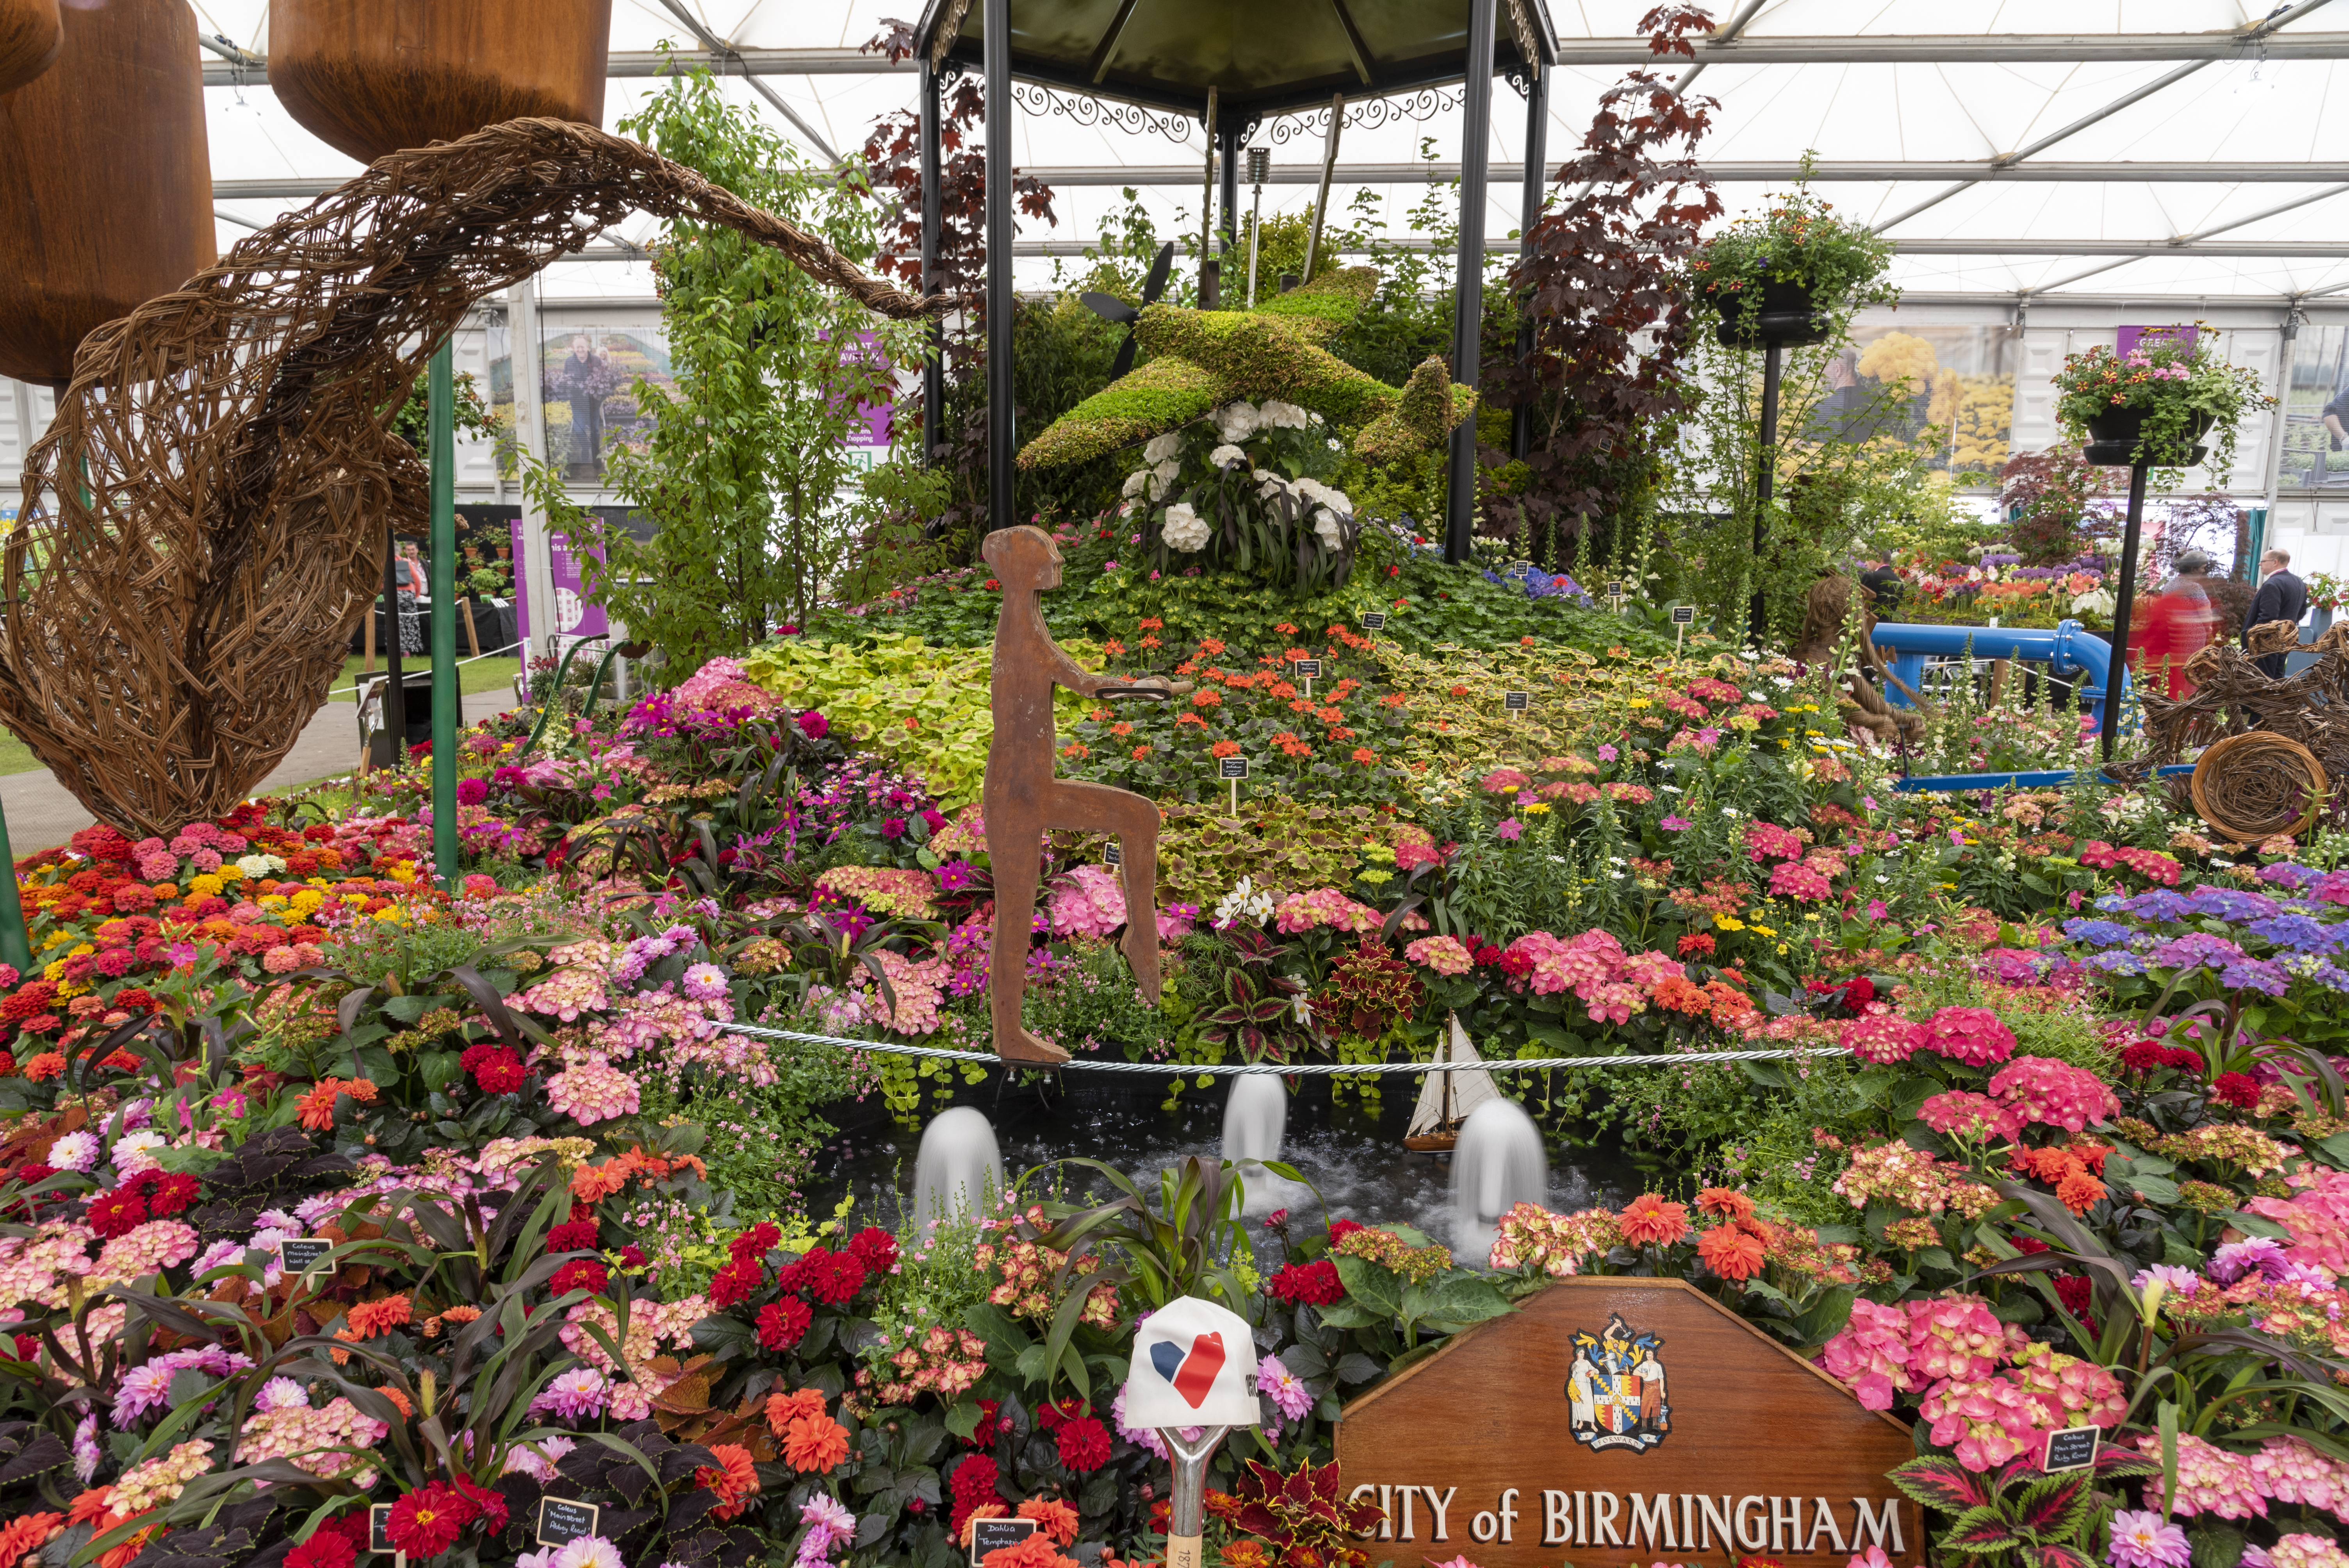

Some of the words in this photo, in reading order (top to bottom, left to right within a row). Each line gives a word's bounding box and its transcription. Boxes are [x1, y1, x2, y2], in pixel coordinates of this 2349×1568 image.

[841, 342, 872, 351] REAT
[1597, 1437, 1638, 1446] FORWARD
[558, 1504, 577, 1514] Coleus
[1349, 1483, 1458, 1540] CITY
[1474, 1488, 1518, 1542] of
[1544, 1490, 1905, 1553] BIRMINGHAM
[549, 1521, 568, 1534] Abbey
